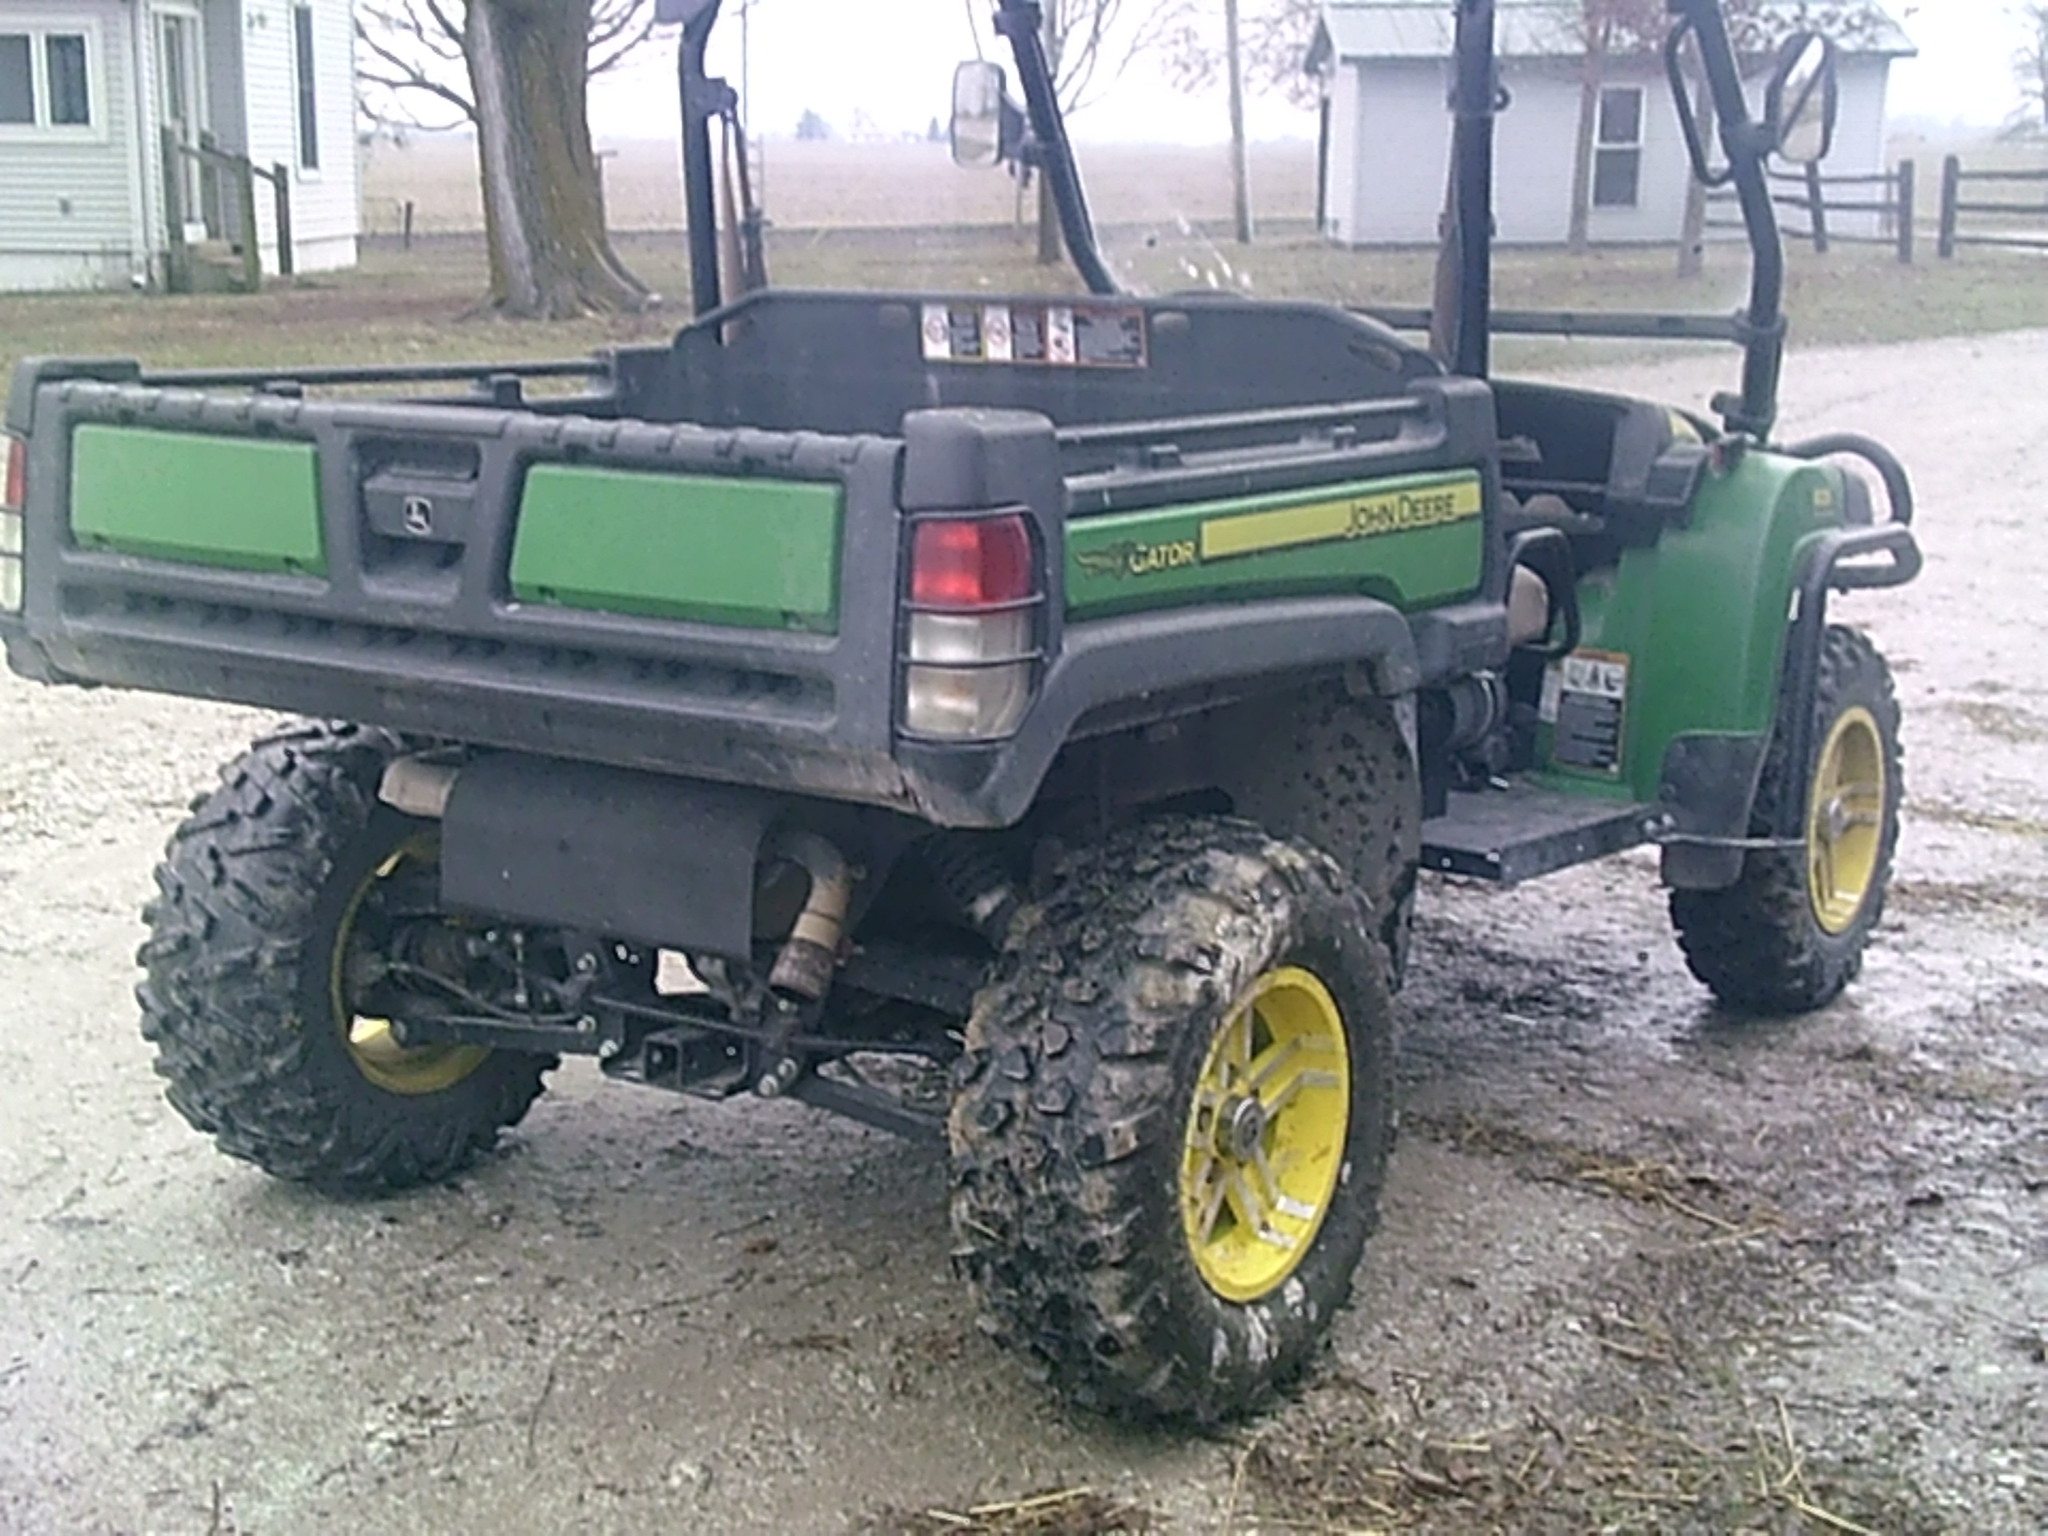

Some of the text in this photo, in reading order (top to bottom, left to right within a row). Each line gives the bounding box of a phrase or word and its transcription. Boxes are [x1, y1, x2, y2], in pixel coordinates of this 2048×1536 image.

[1346, 493, 1456, 536] JOHN DEERE
[1130, 540, 1195, 573] GATOR
